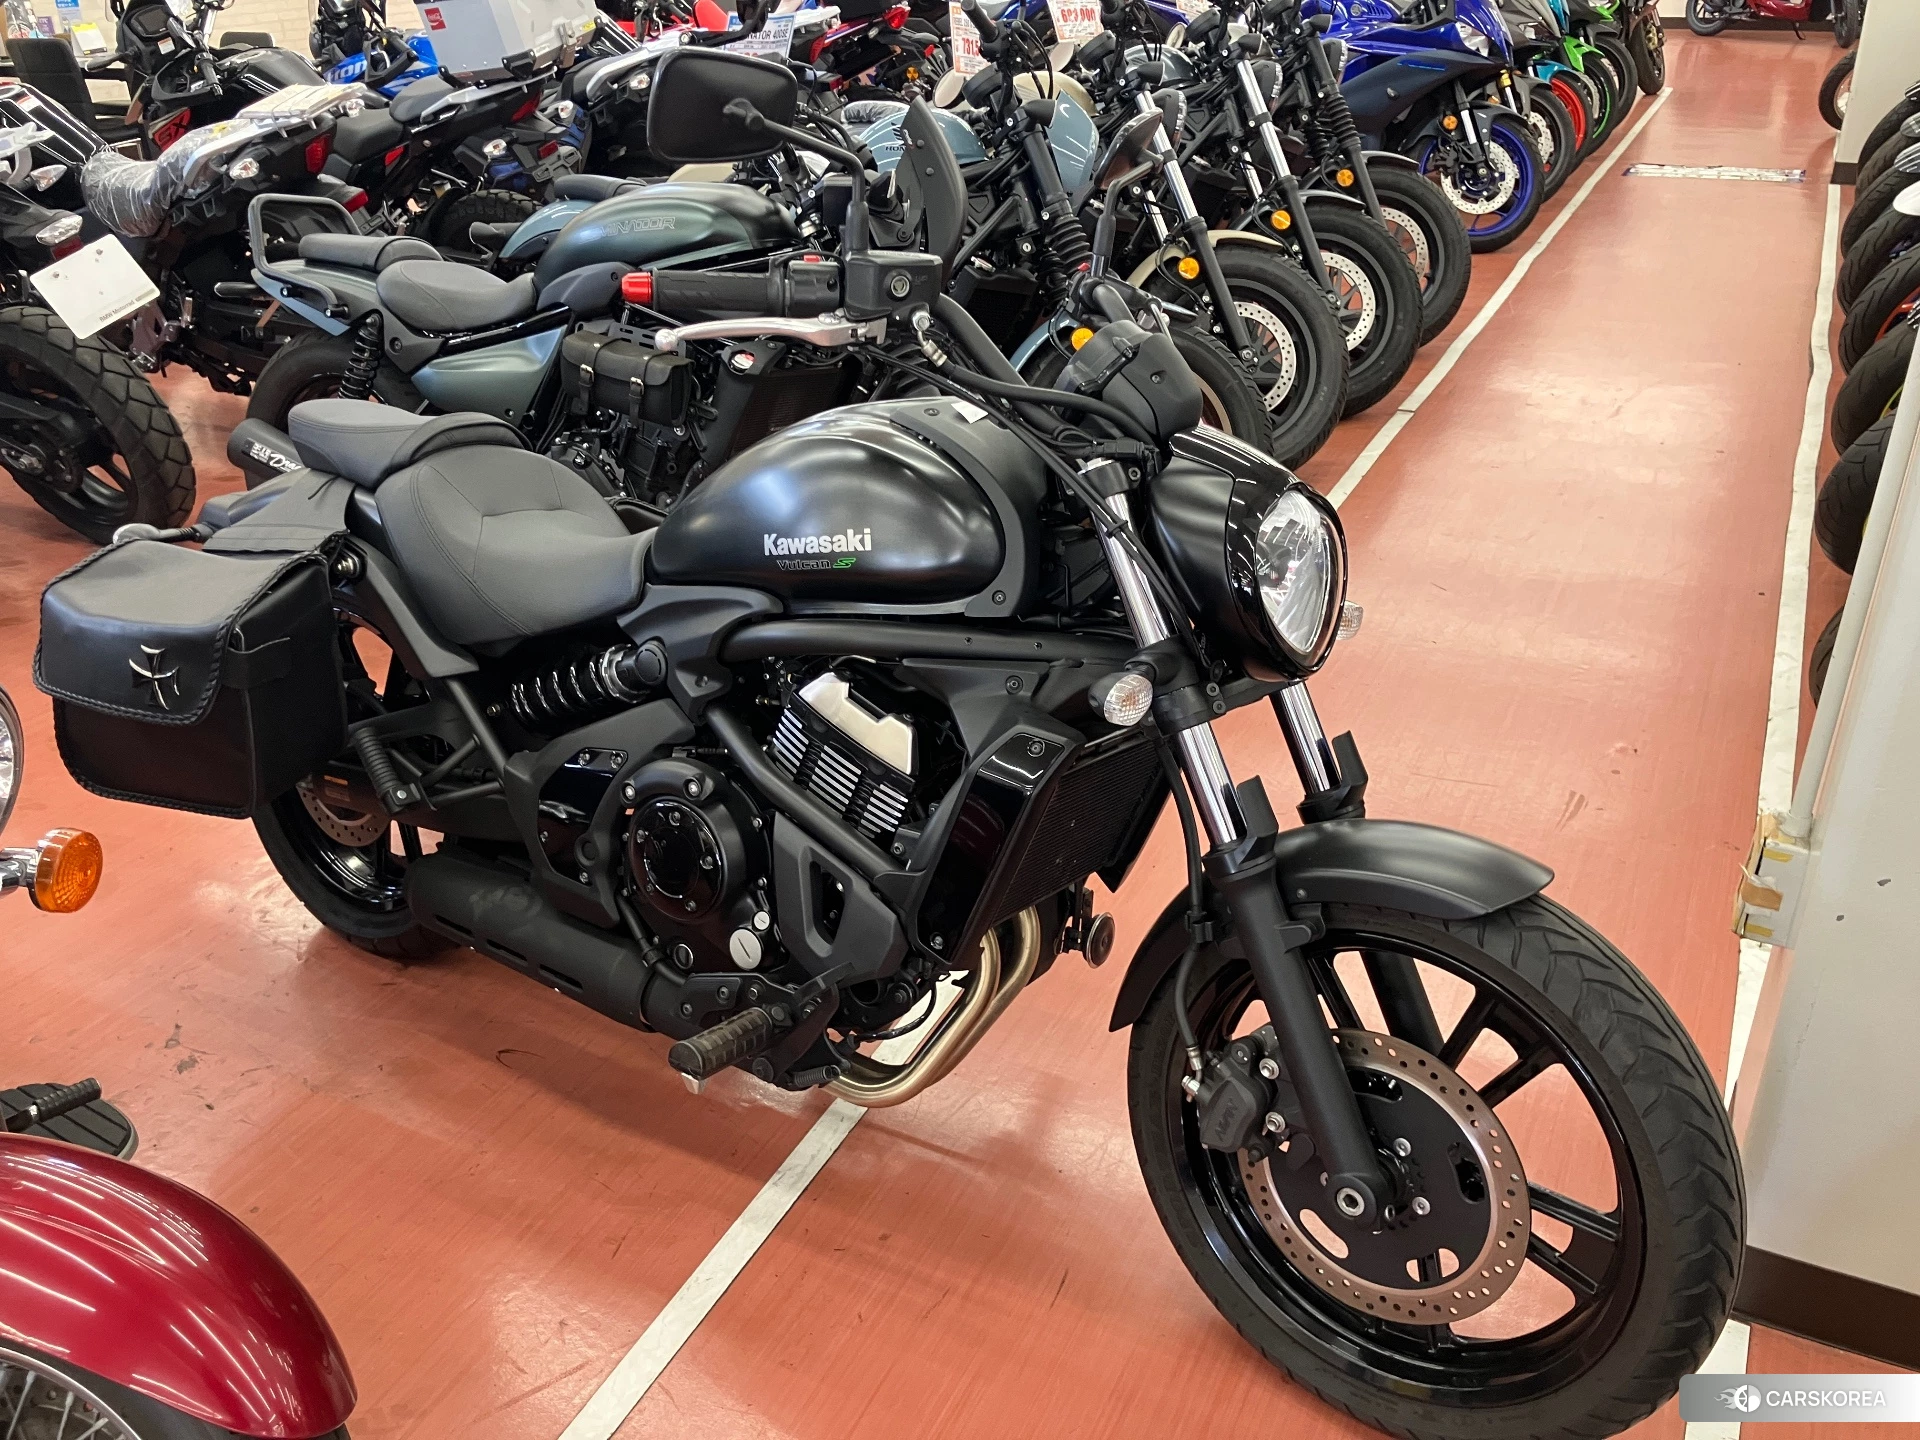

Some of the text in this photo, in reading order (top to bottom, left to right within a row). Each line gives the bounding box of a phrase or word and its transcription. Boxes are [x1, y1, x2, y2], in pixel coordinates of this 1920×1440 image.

[99, 310, 114, 322] BMW
[764, 528, 872, 556] Kawasaki
[776, 557, 856, 570] Vulcan S
